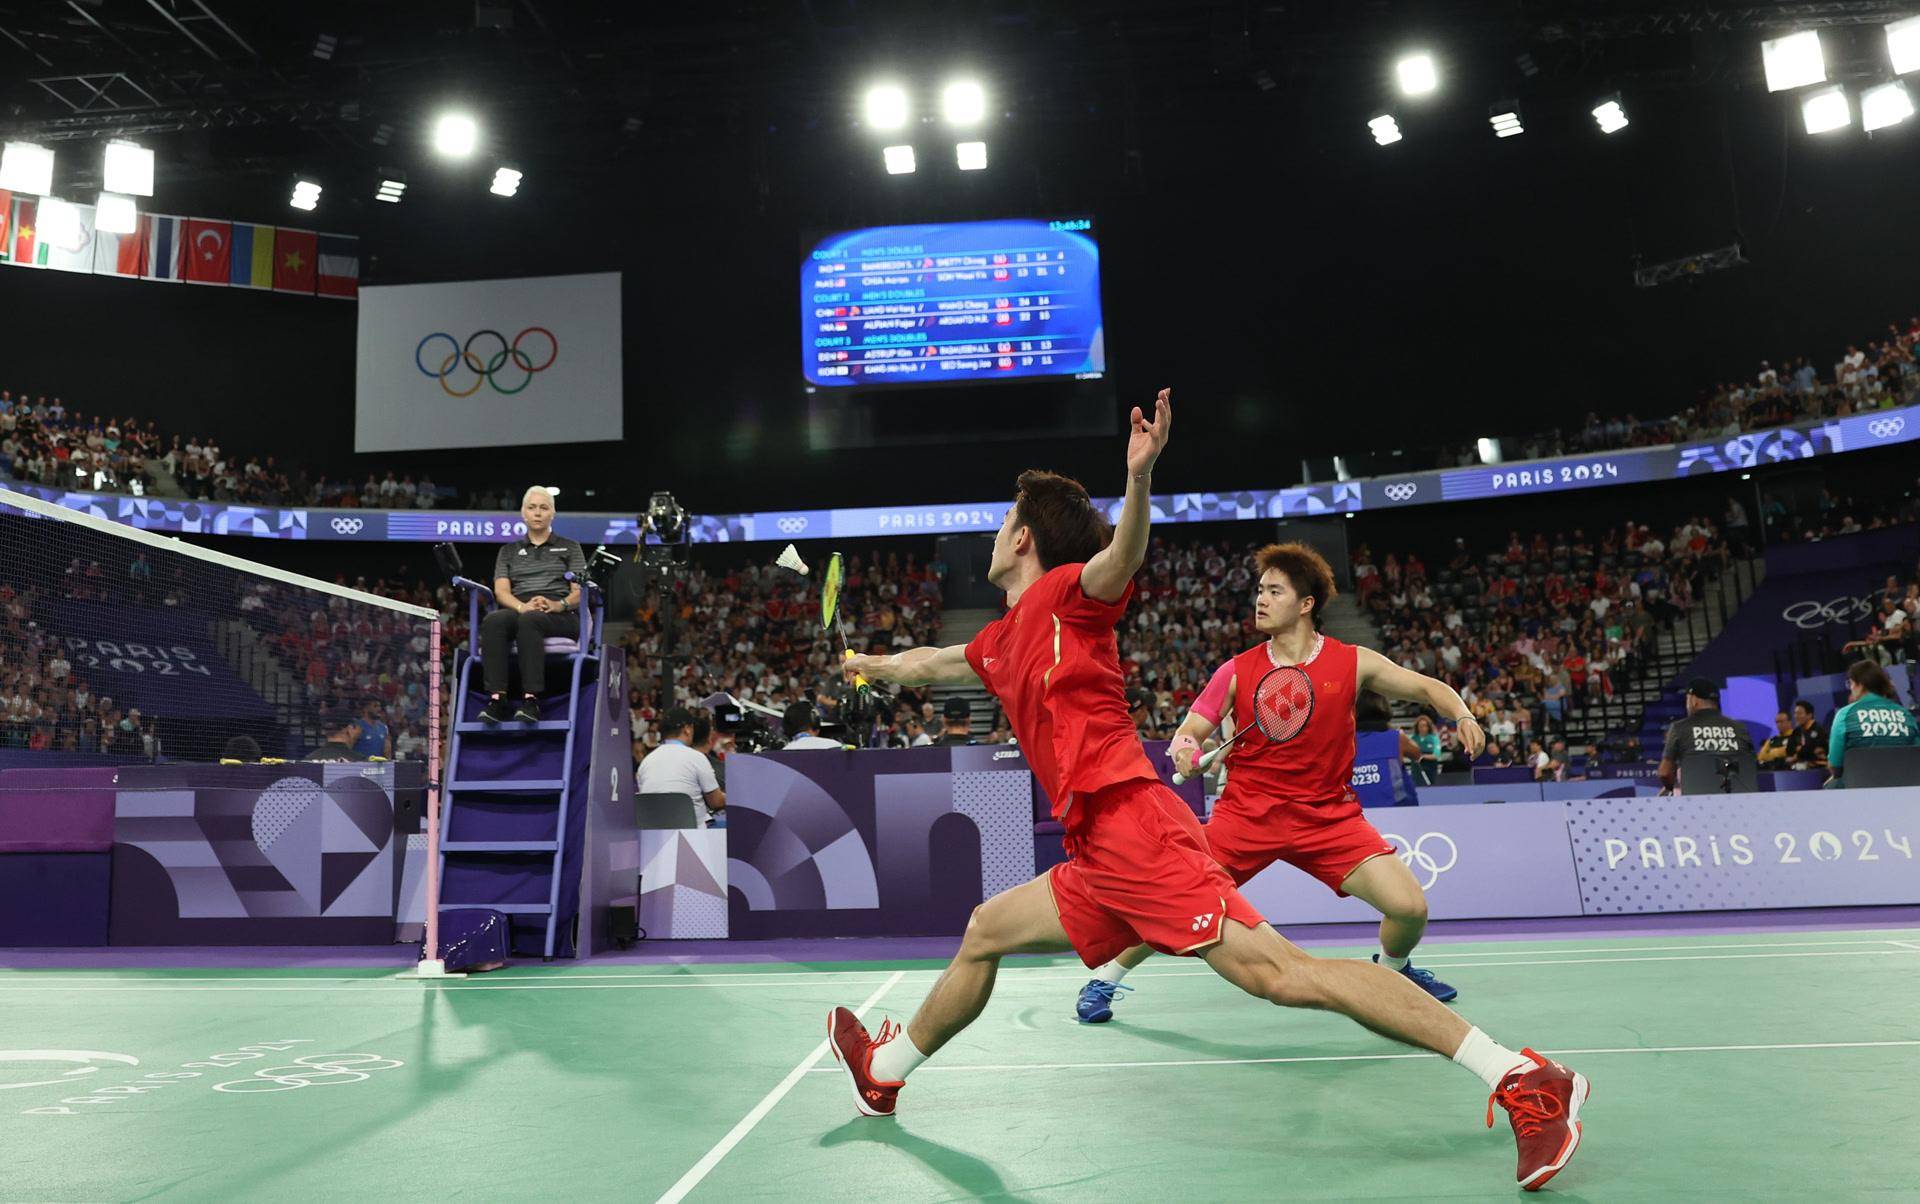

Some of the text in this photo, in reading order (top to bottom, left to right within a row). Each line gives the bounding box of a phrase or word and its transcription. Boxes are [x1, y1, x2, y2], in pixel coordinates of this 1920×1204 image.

[1492, 462, 1618, 490] PARIS 2024
[437, 520, 528, 536] PARIS 20
[879, 510, 994, 529] PARIS 2024
[65, 637, 197, 661] PARIS
[1857, 709, 1906, 723] PARIS
[1692, 726, 1736, 739] PARIS
[1860, 722, 1909, 737] 2024
[1694, 738, 1739, 751] 2024
[611, 767, 619, 801] 2
[1351, 773, 1380, 786] 0230
[1774, 829, 1913, 865] 2024
[181, 1038, 315, 1068] 2024
